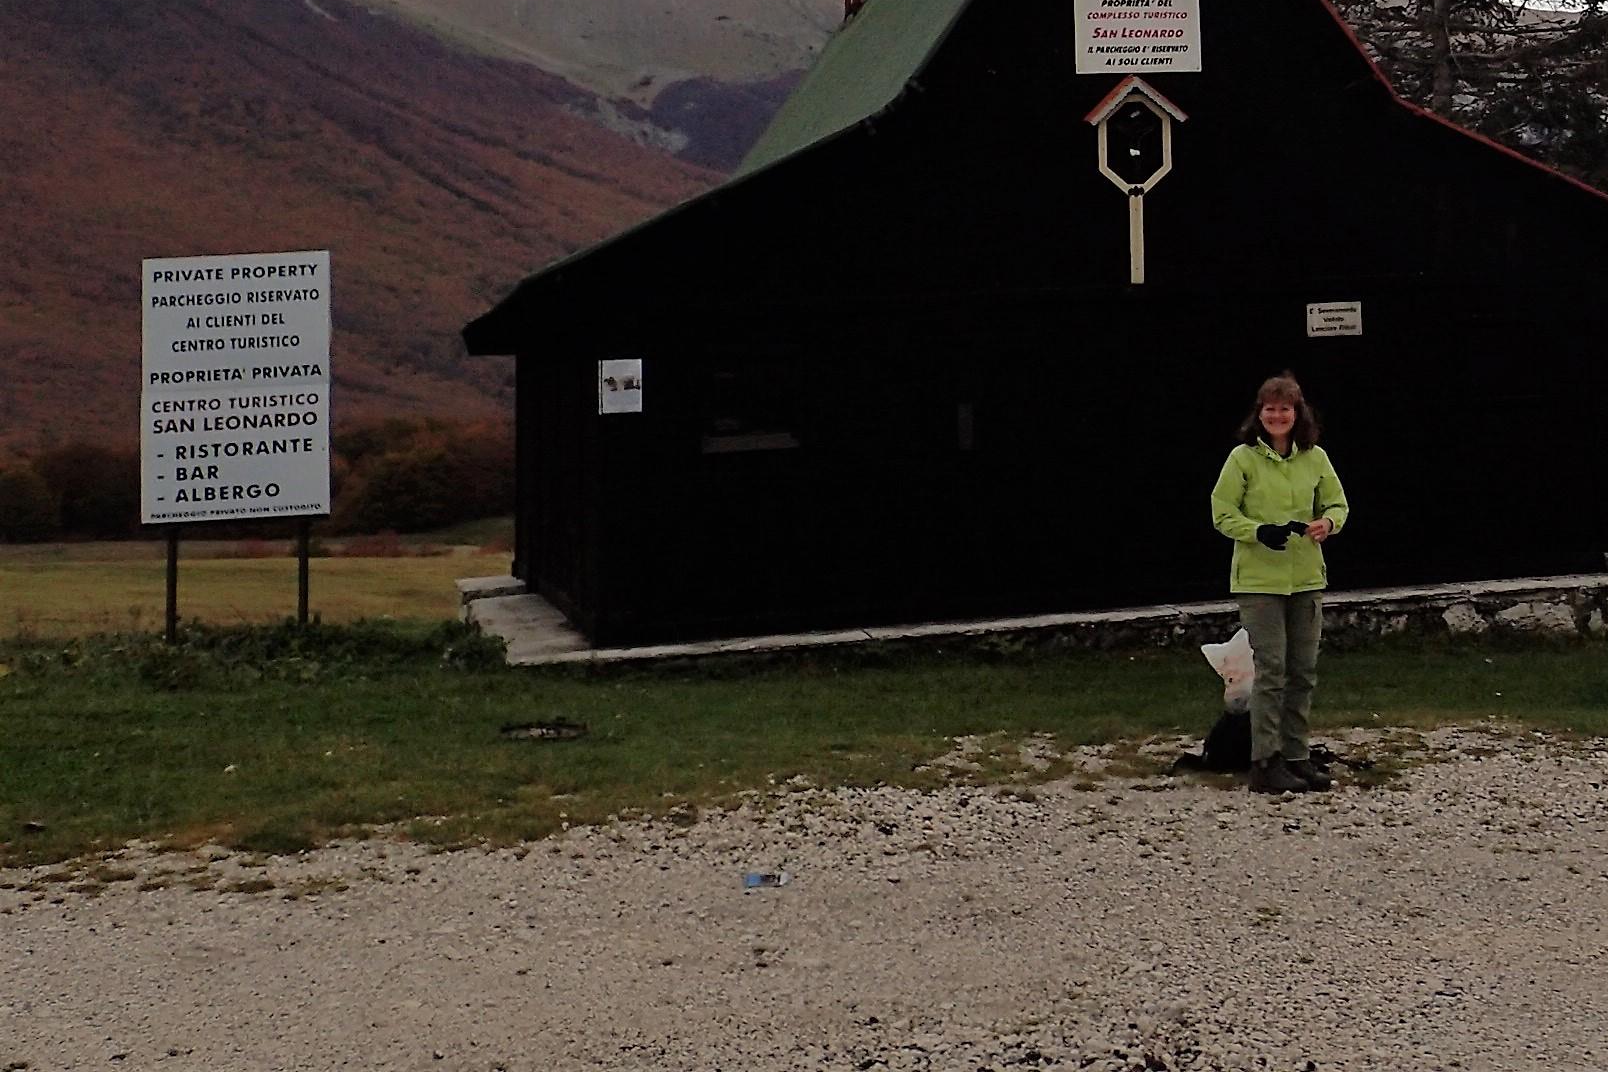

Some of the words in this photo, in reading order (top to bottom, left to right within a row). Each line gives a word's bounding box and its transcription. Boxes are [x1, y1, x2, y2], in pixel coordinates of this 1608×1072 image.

[1096, 45, 1139, 53] PARCHEGGIO
[153, 269, 224, 282] PRIVATE
[231, 264, 319, 279] PROPERTY
[151, 293, 242, 308] PARCHEGGIO
[247, 289, 320, 303] RISERVATO
[186, 318, 200, 329] AI
[205, 315, 256, 328] CLIENTI
[261, 314, 285, 325] DEL
[172, 339, 226, 352] CENTRO
[230, 336, 300, 349] TURISTICO
[150, 369, 246, 384] PROPRIETA'
[252, 364, 322, 378] PRIVATA
[152, 399, 221, 413] CENTRO
[229, 393, 319, 409] TURISTICO
[152, 419, 196, 434] SAN
[203, 411, 318, 431] LEONARDO
[175, 438, 314, 460] RISTORANTE
[176, 466, 220, 481] BAR
[175, 483, 281, 502] ALBERGO
